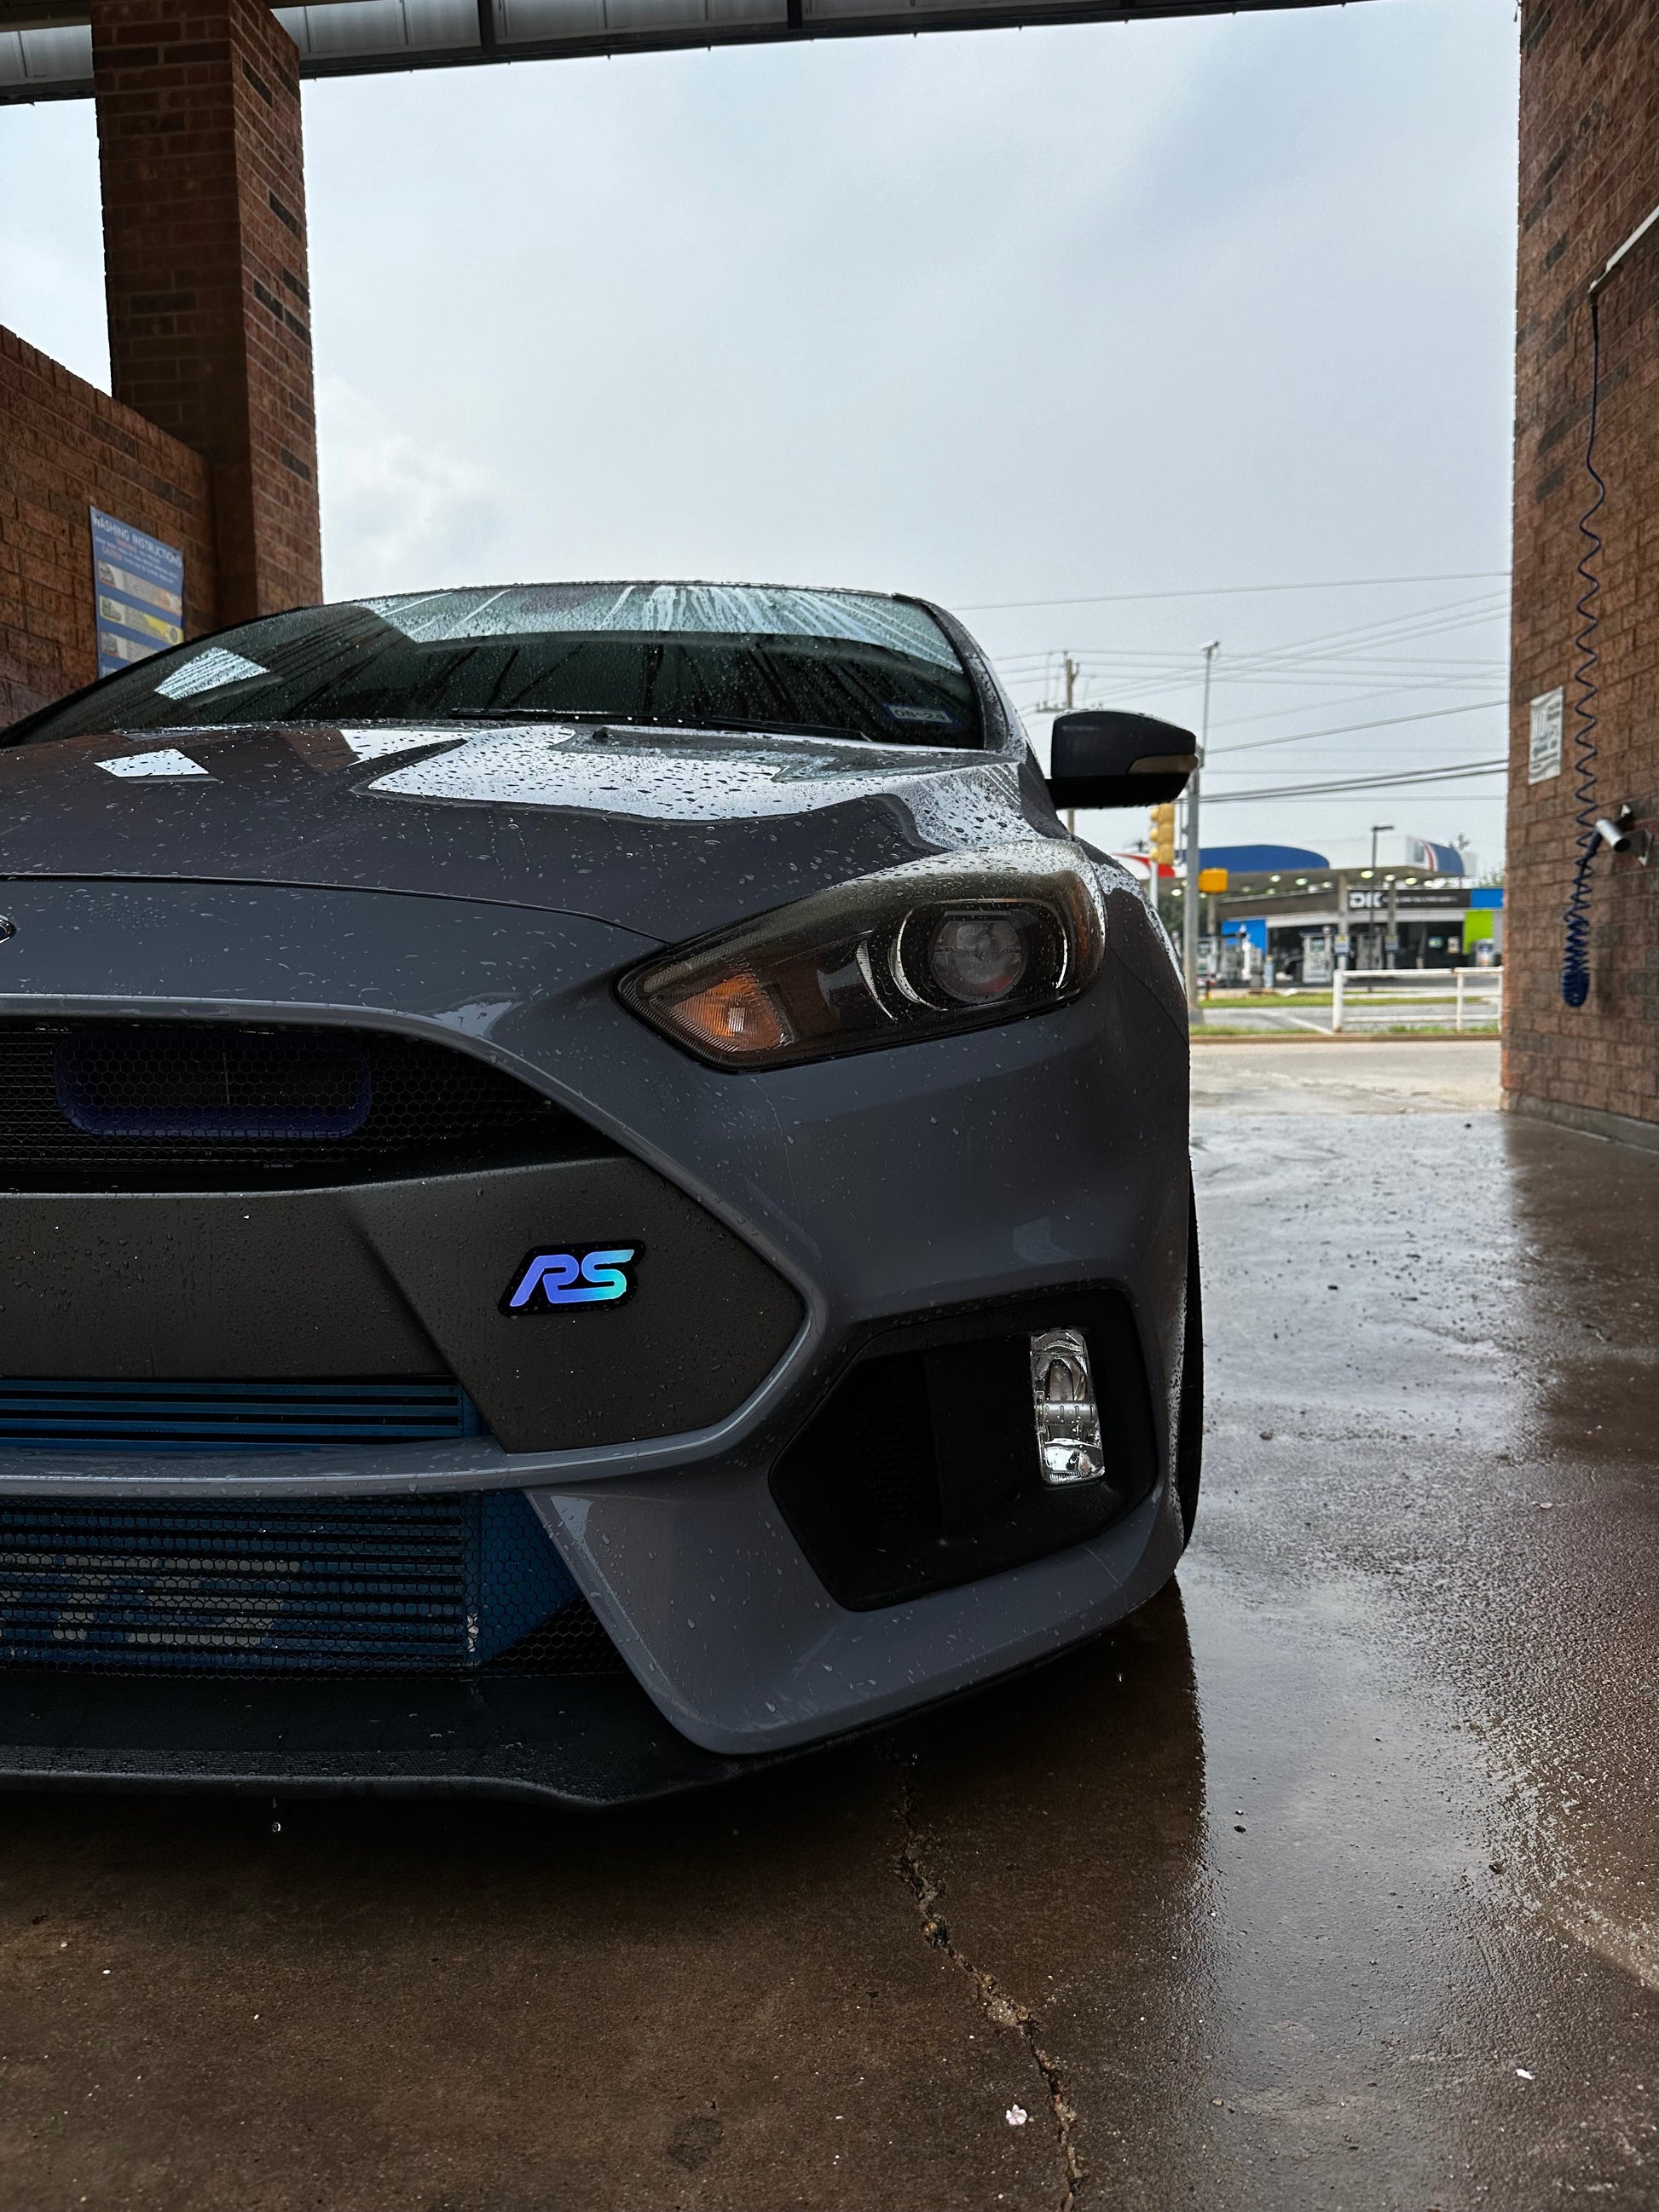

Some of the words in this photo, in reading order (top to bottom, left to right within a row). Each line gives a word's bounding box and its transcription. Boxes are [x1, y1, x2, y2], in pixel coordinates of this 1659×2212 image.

[92, 513, 130, 542] WASHING
[132, 533, 182, 569] INSTRUCTIONS
[1350, 891, 1384, 908] DK
[510, 1249, 634, 1307] RS
